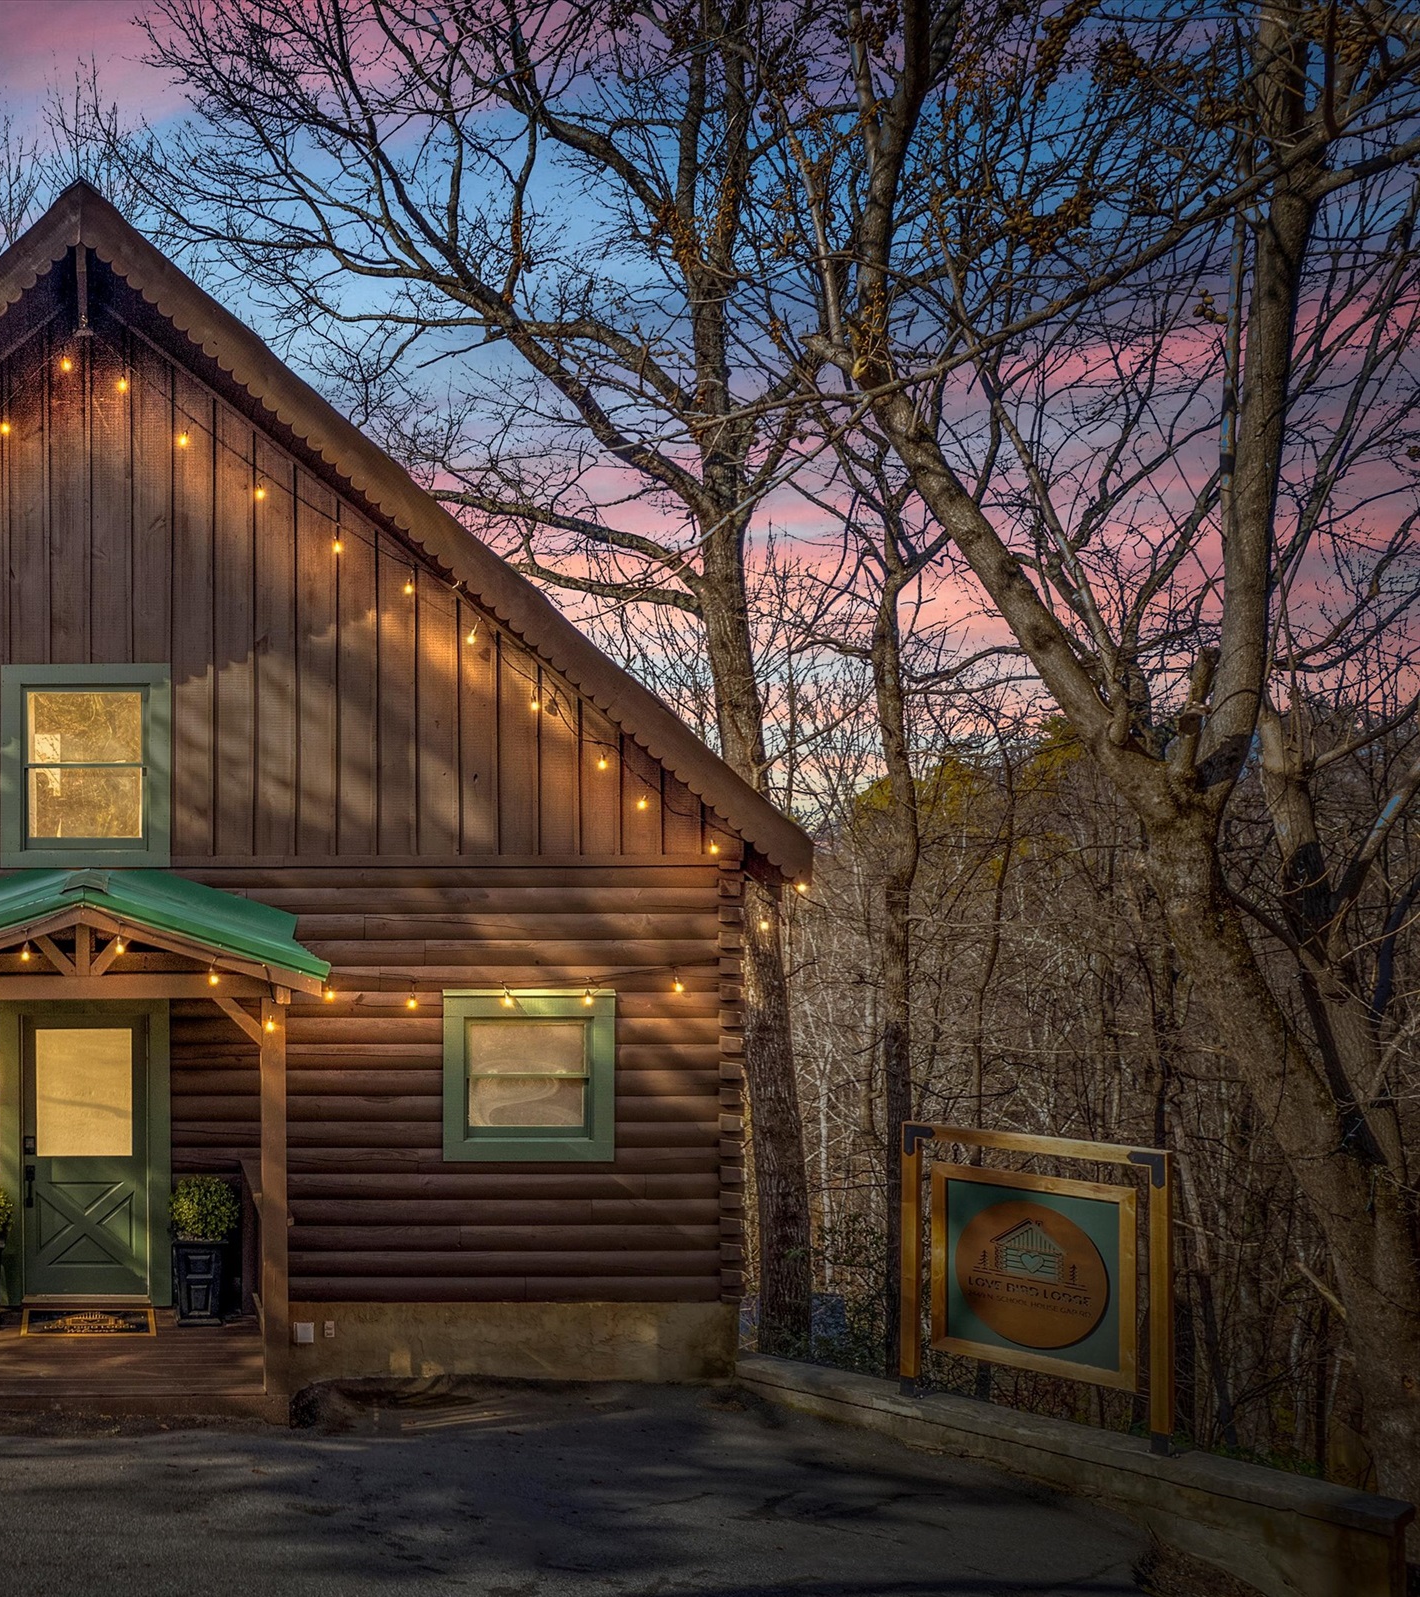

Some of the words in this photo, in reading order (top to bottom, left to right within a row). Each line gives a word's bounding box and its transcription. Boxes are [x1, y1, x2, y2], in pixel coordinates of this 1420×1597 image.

[968, 1275, 1002, 1290] LOVE
[1006, 1282, 1039, 1297] BIRD
[1043, 1288, 1092, 1307] LODGE
[996, 1295, 1027, 1306] SCHOOL
[1030, 1301, 1058, 1312] HOUSE
